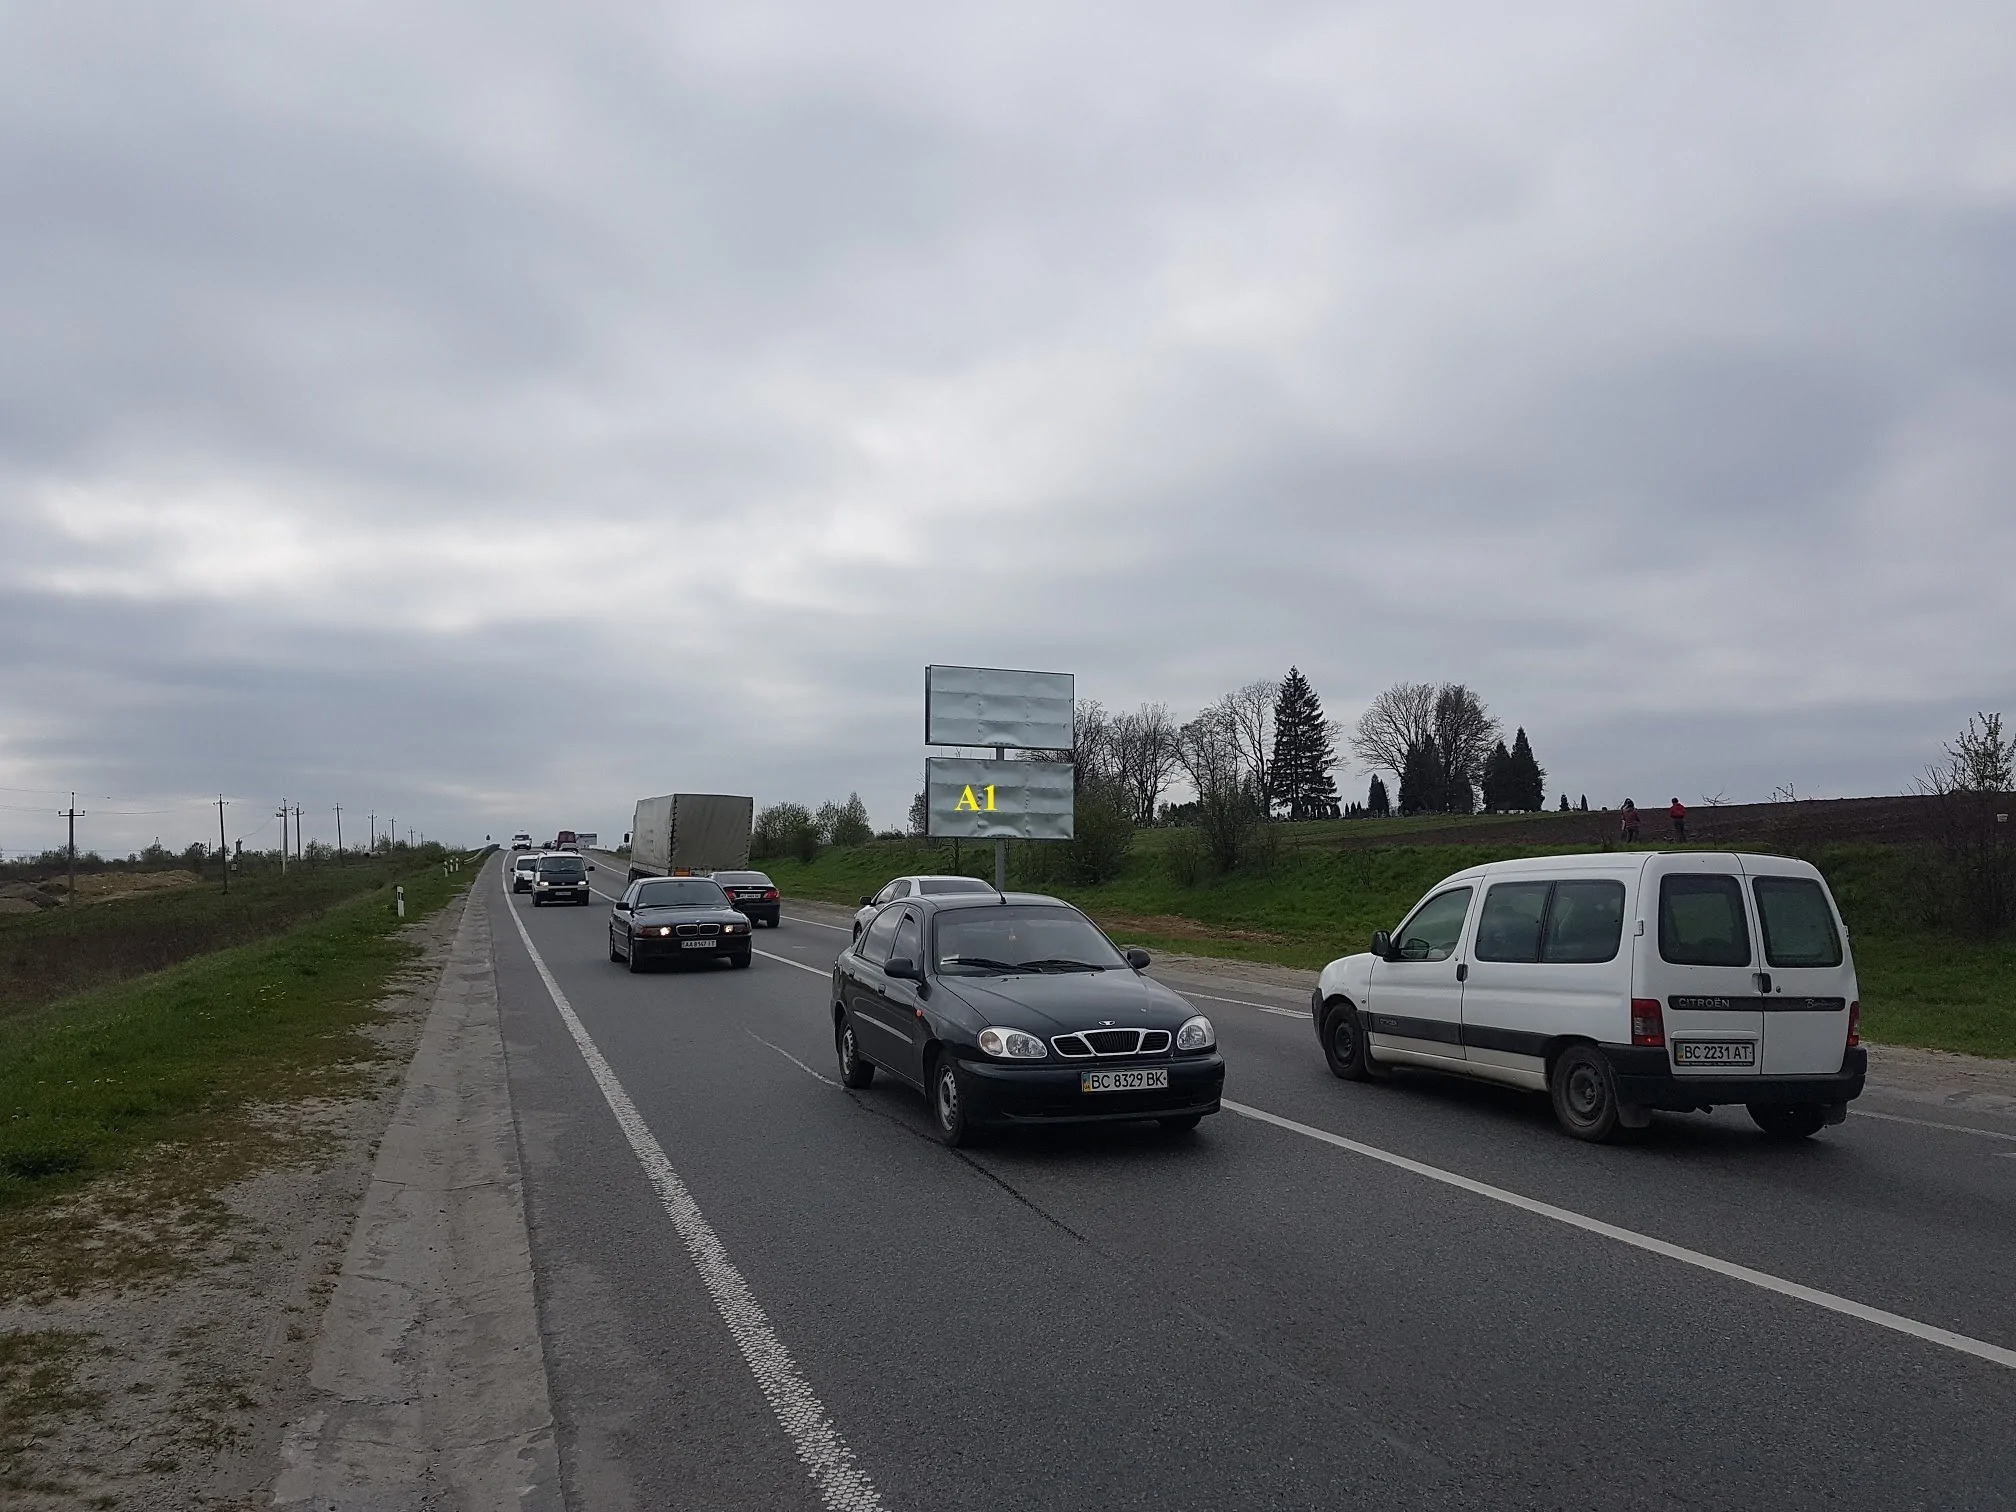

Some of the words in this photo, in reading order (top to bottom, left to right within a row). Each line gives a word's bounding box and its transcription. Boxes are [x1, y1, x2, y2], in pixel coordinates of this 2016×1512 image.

[1678, 997, 1730, 1007] CITROËN
[1685, 1046, 1701, 1060] BC
[1704, 1046, 1730, 1060] 2231
[1734, 1046, 1750, 1060] AT
[1092, 1074, 1111, 1089] BC
[1113, 1072, 1143, 1088] 8329
[1146, 1071, 1165, 1087] BK
